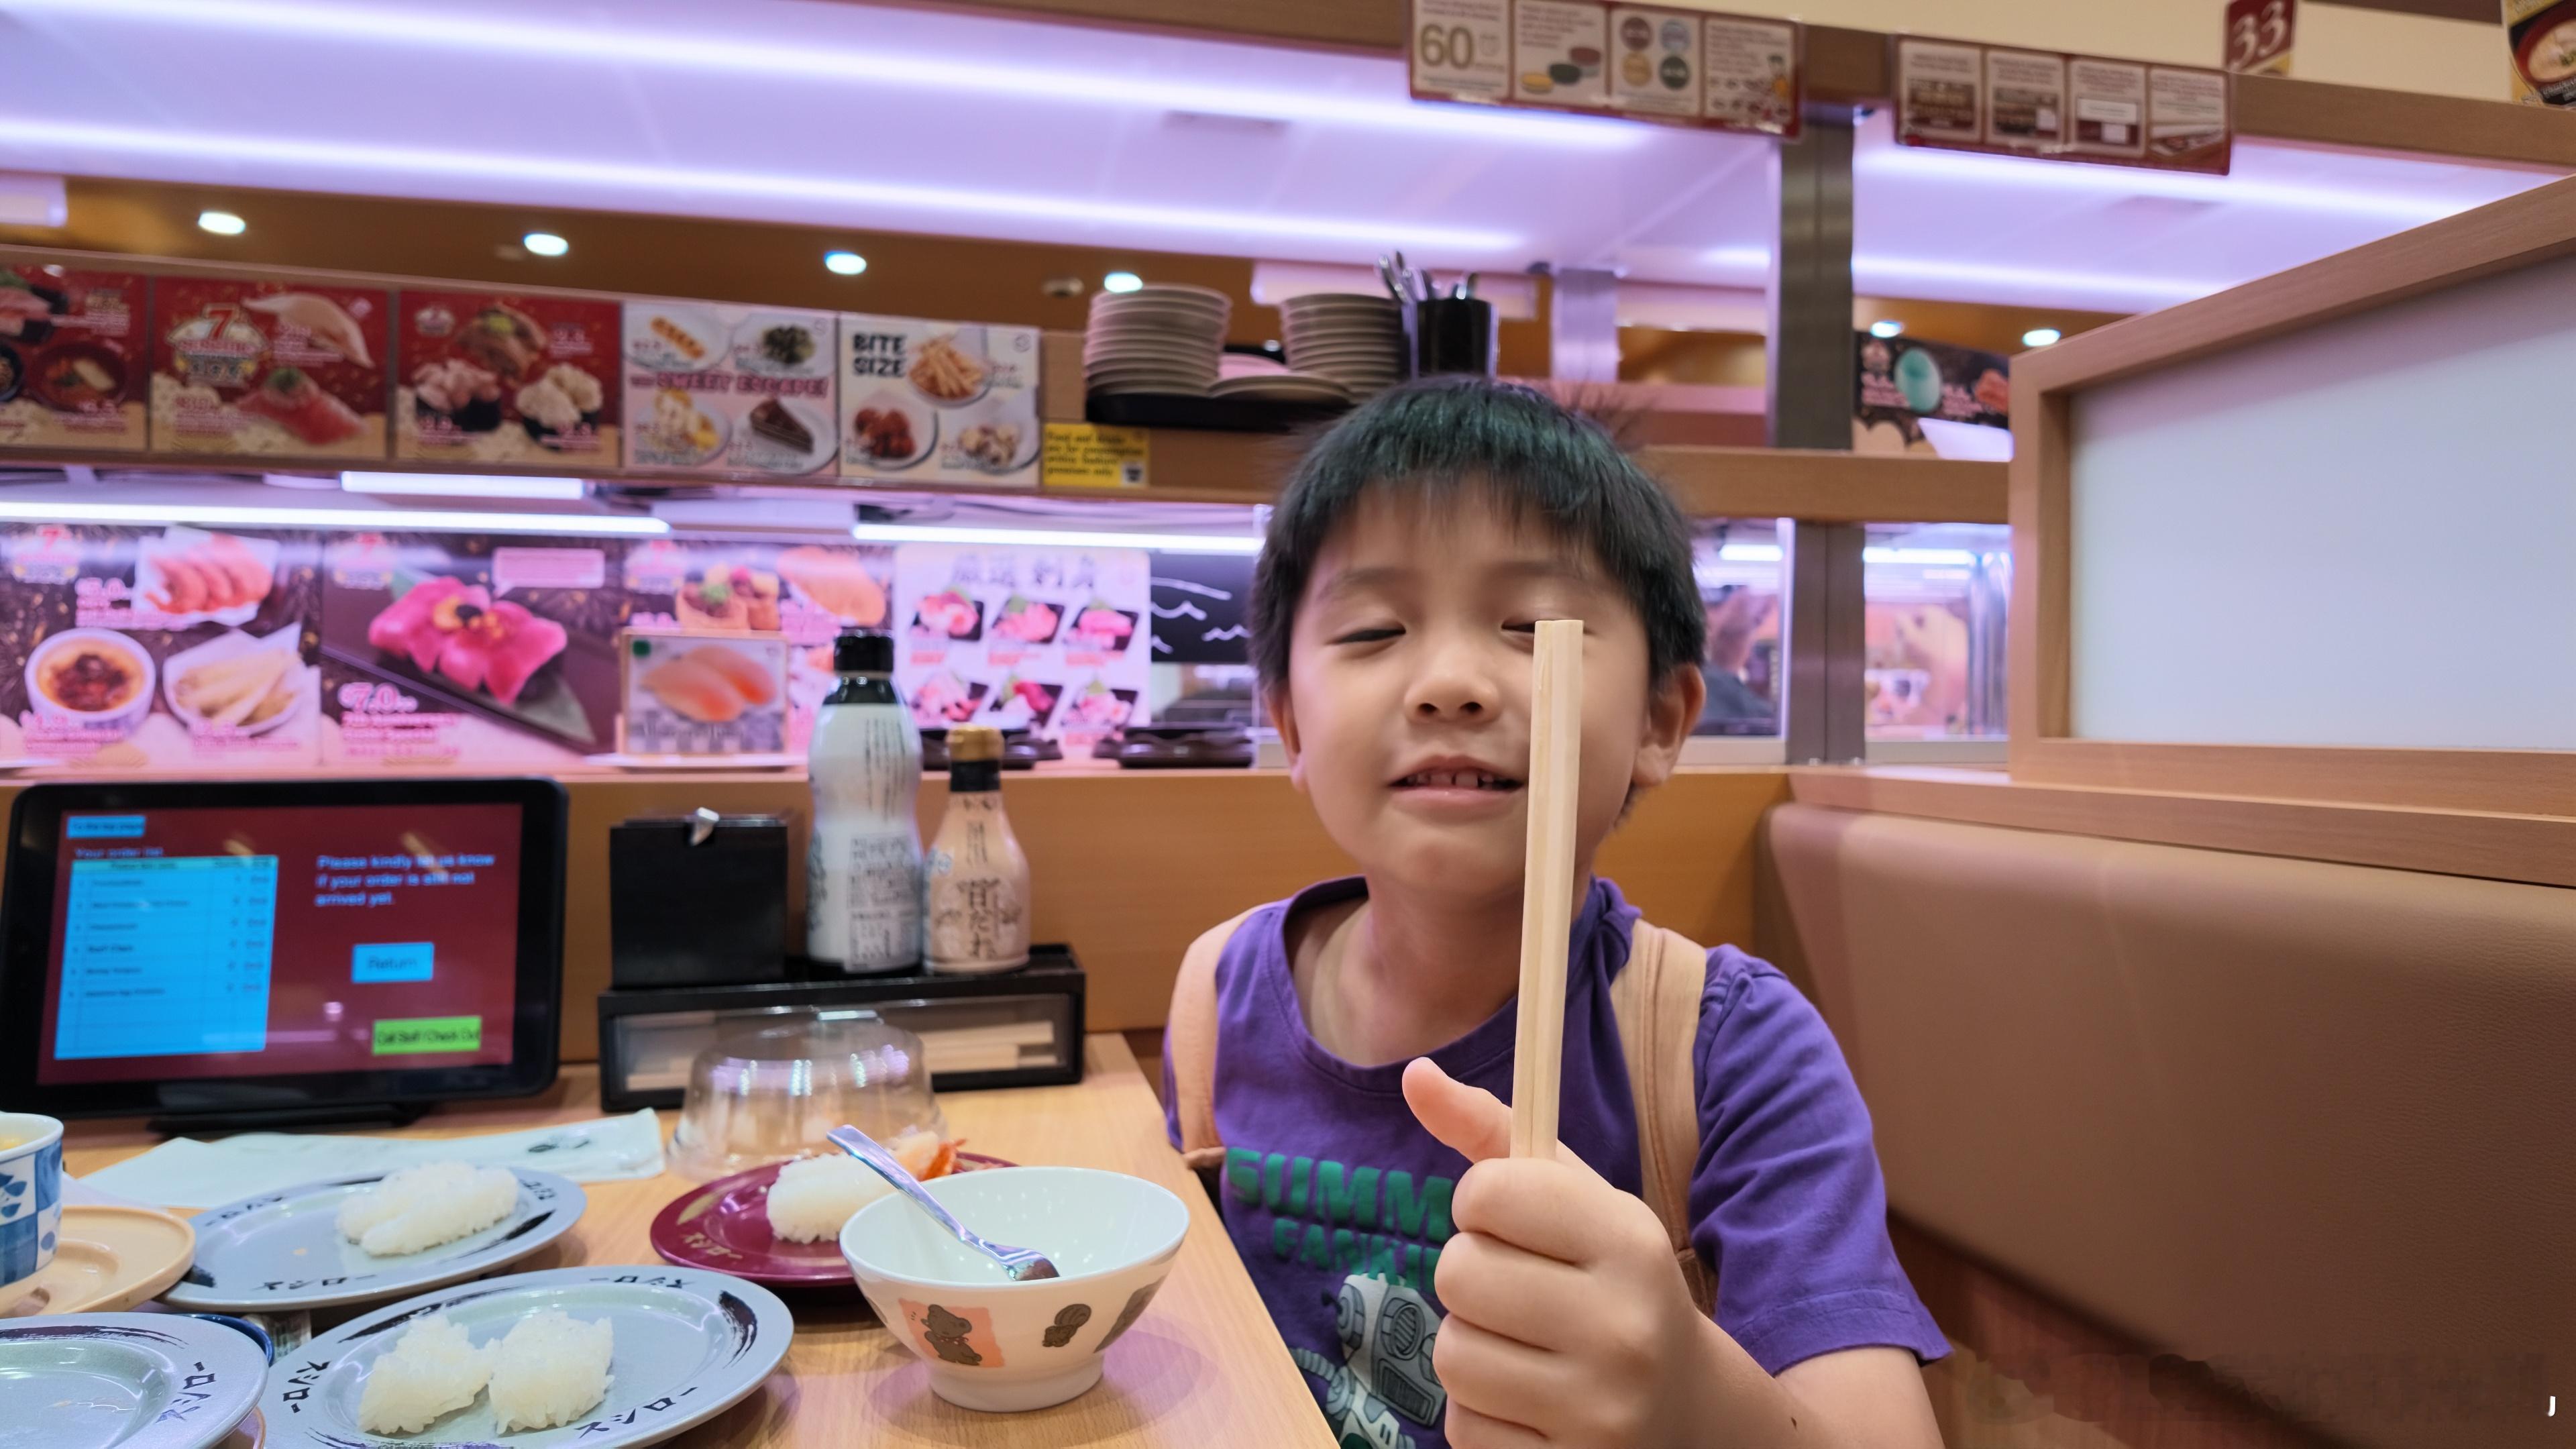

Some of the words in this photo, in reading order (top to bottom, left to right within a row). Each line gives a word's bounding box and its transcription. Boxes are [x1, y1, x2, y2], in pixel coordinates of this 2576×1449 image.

[2229, 1, 2286, 71] 33
[1420, 23, 1474, 70] 60
[853, 333, 908, 354] BITE
[853, 357, 906, 376] SIZE
[318, 855, 367, 869] Please
[370, 855, 411, 869] kindly
[458, 853, 495, 866] know
[331, 875, 362, 890] your
[366, 874, 402, 887] order
[408, 874, 419, 885] is
[453, 871, 474, 884] not
[315, 893, 366, 907] arrived
[369, 955, 418, 971] Return
[1226, 1146, 1453, 1244] SUMM
[250, 1273, 377, 1292] スシロー
[589, 1275, 698, 1289] スシロー
[154, 1360, 217, 1424] スシロー
[282, 1359, 332, 1415] スシロー
[573, 1386, 699, 1439] スシロー
